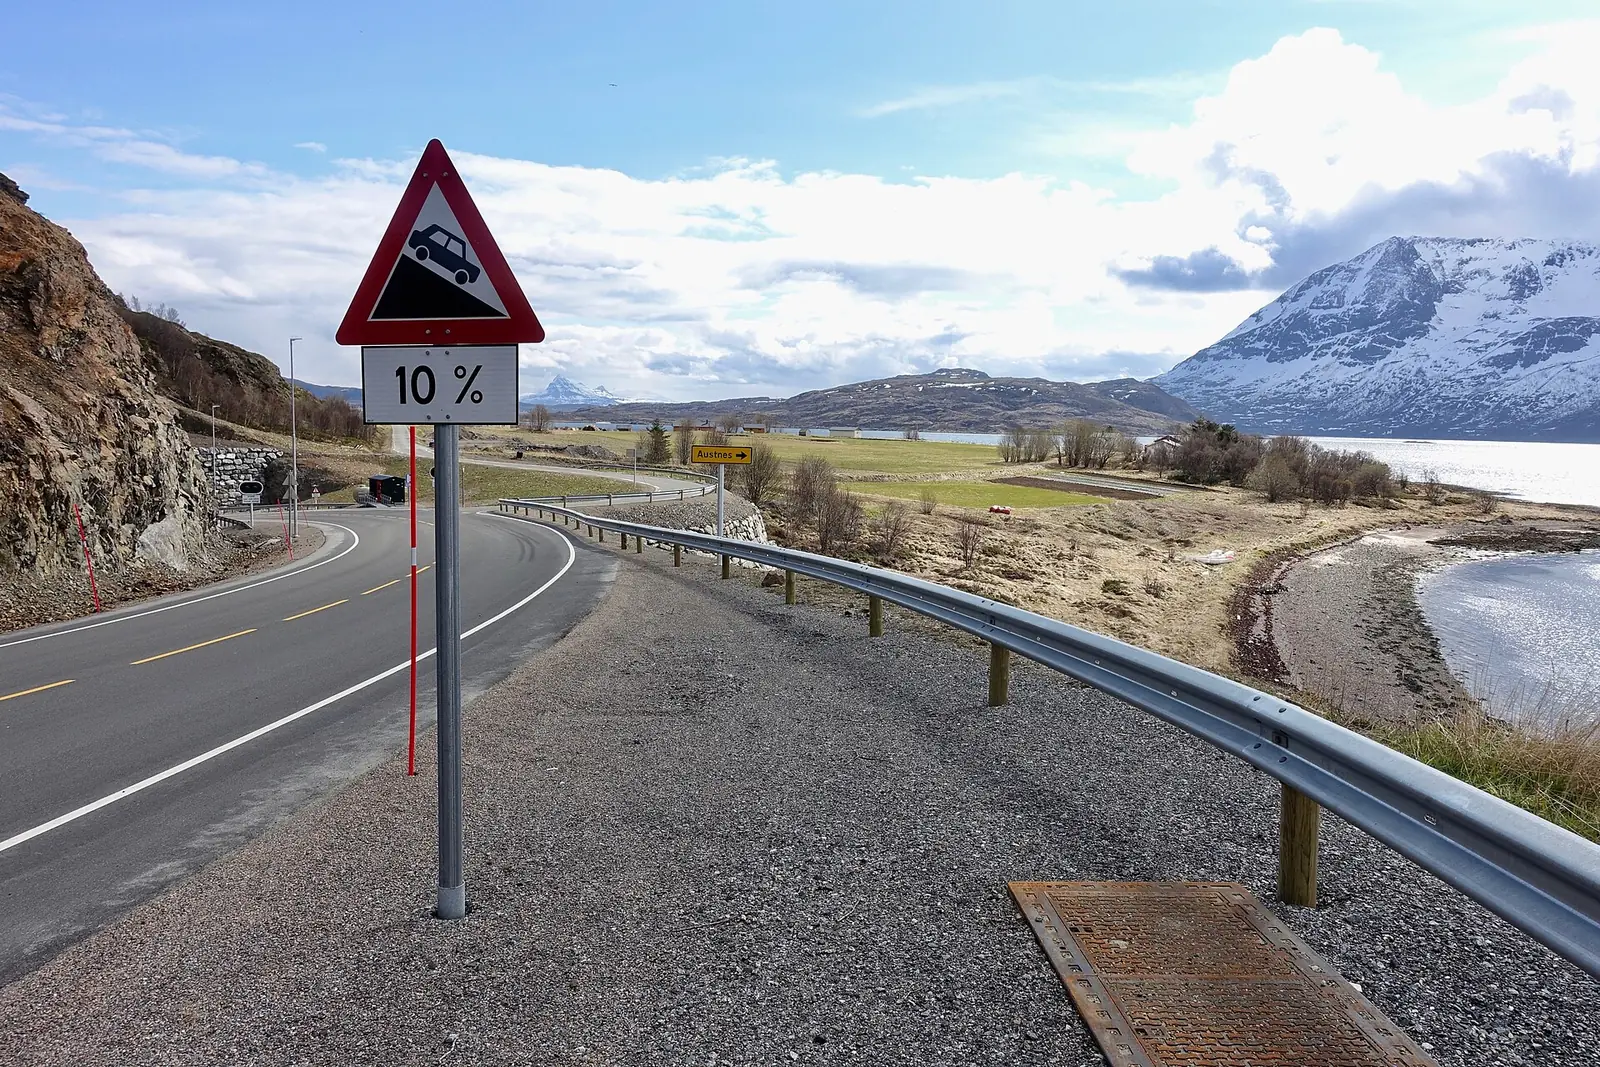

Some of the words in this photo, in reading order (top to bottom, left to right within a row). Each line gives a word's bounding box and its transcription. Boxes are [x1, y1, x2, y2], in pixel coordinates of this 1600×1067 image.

[395, 364, 436, 405] 10
[454, 364, 483, 405] %
[697, 449, 733, 459] Austnes
